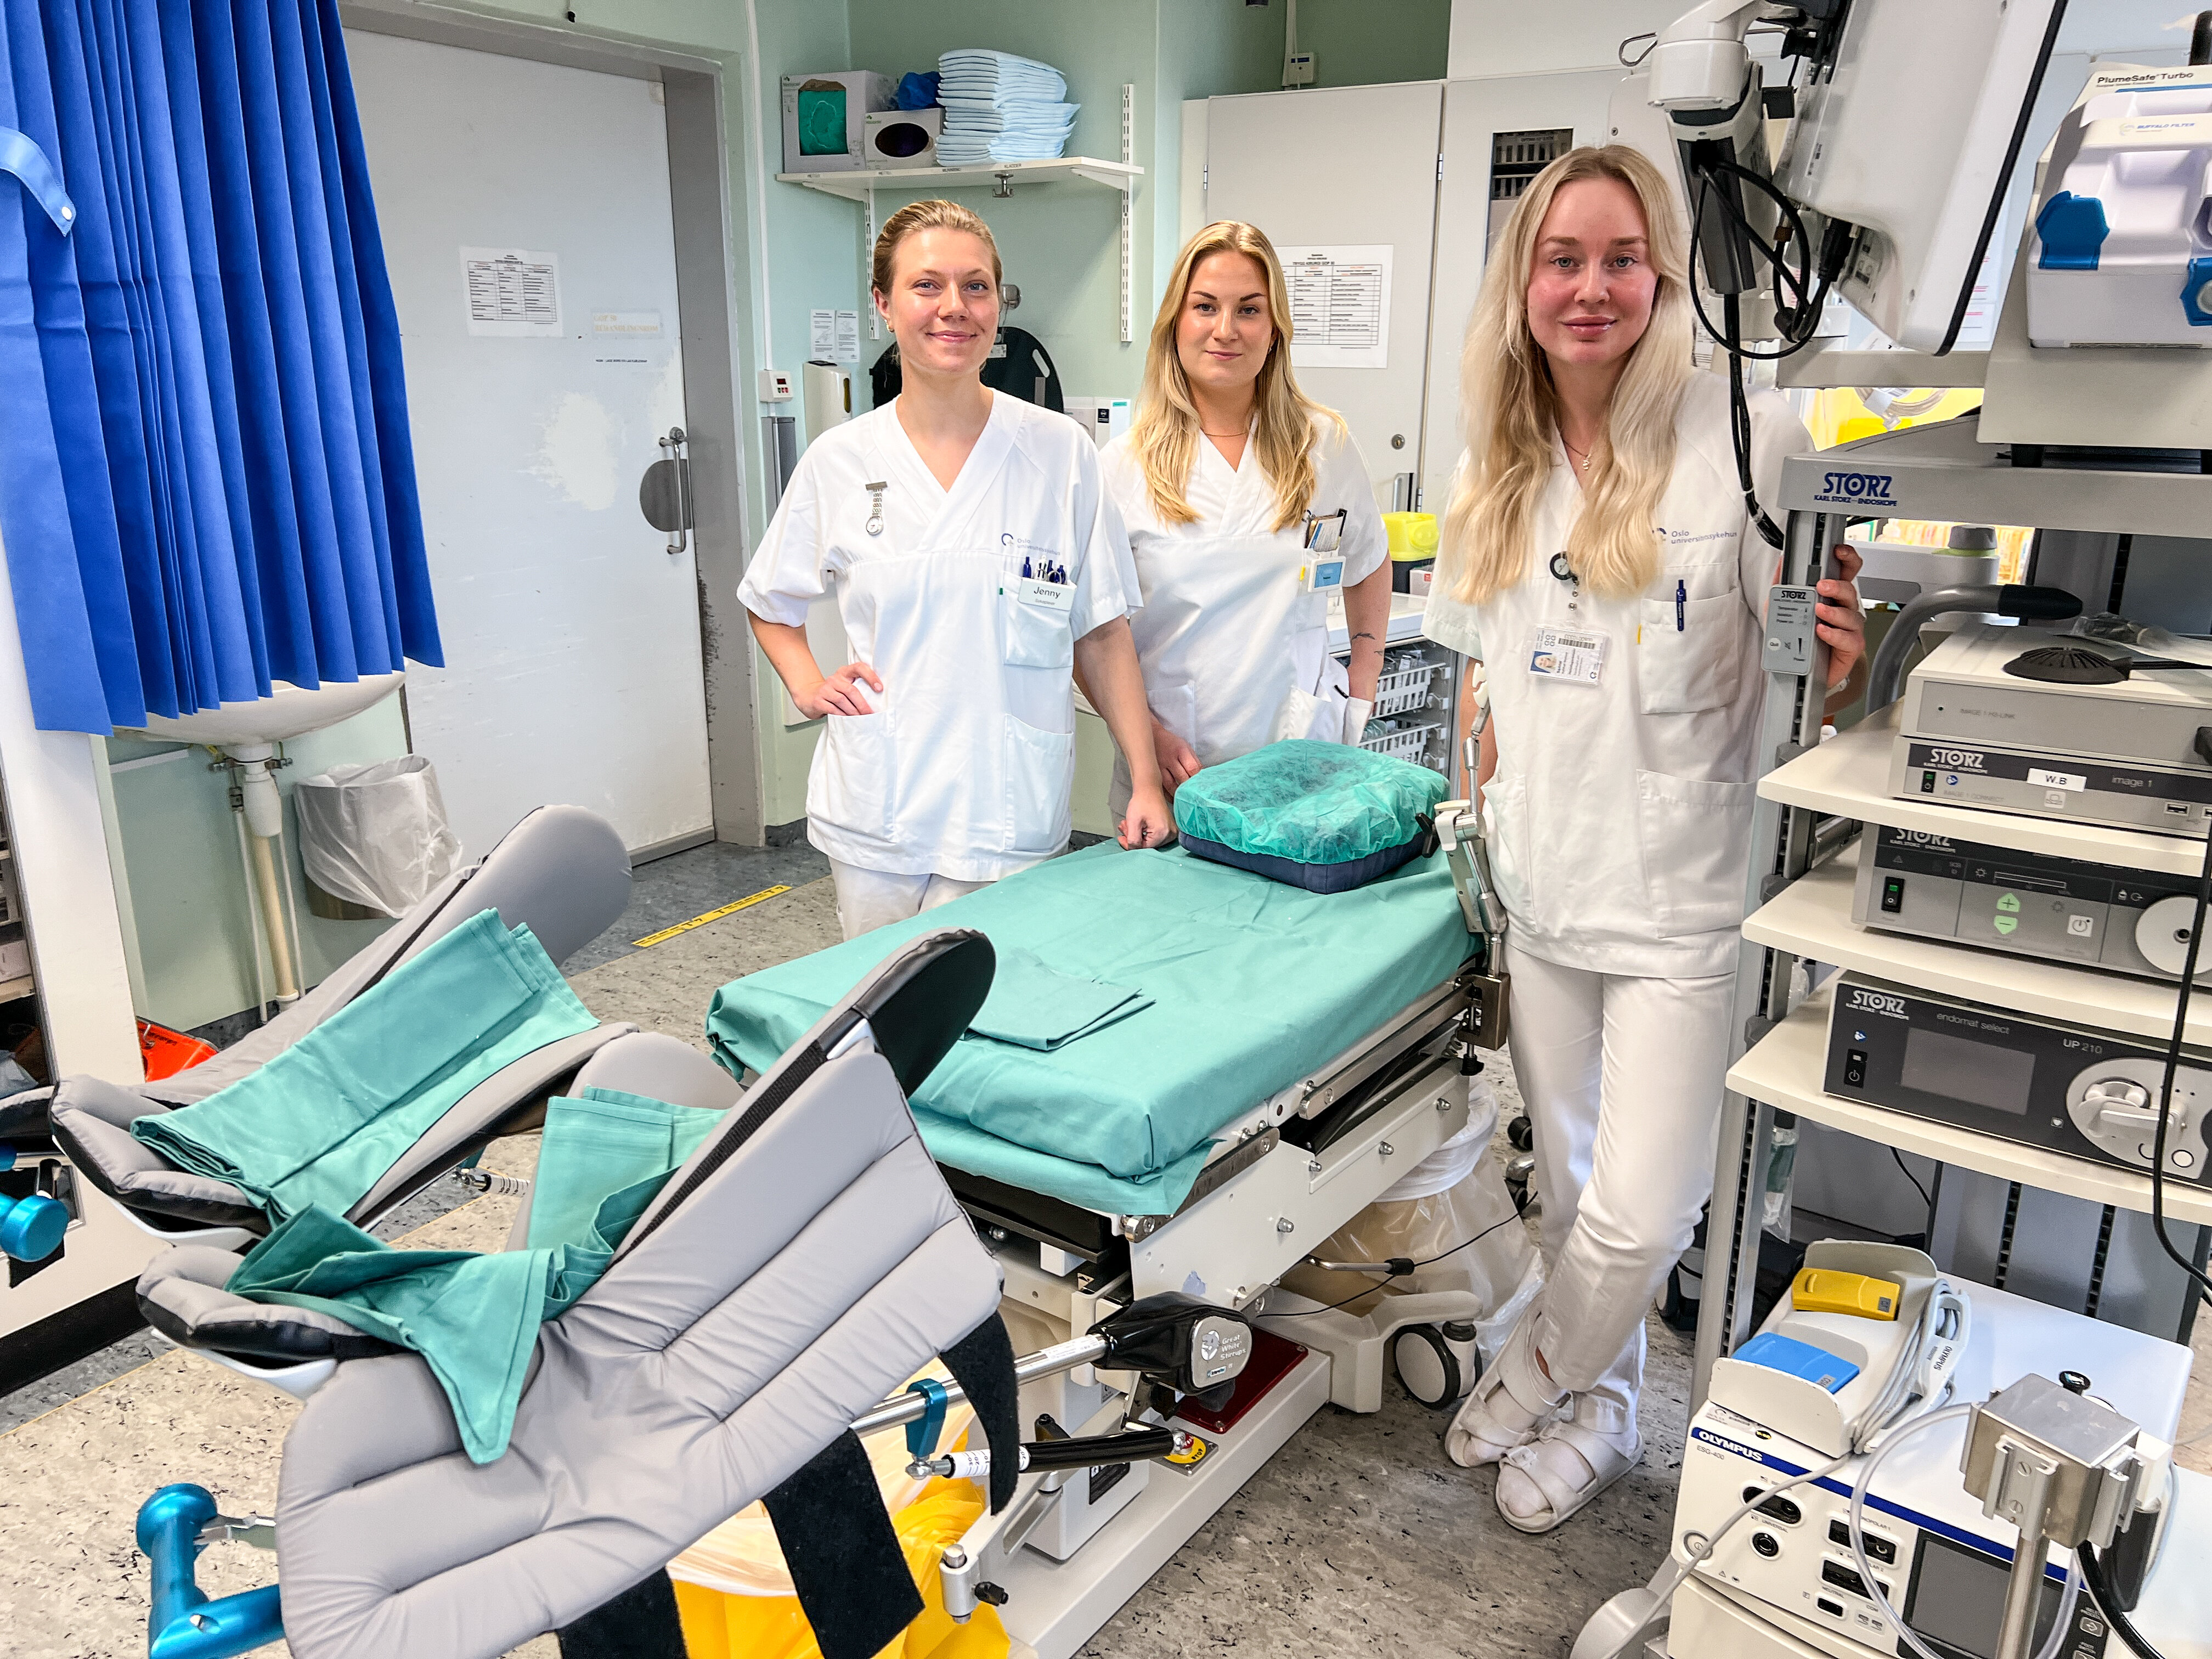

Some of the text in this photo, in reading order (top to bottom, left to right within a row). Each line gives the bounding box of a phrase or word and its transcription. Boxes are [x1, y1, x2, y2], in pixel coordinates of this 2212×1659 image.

[1822, 472, 1893, 498] STORZ
[1858, 498, 1898, 506] ENDOSKOPE
[1034, 586, 1061, 599] Jenny
[1781, 590, 1806, 600] STORZ
[1930, 748, 1984, 768] STORZ
[2112, 775, 2144, 788] image
[1852, 990, 1906, 1014] STORZ
[1937, 1013, 2010, 1035] endomat select
[2063, 1037, 2103, 1054] UP 210
[1222, 1334, 1240, 1345] Great
[1221, 1342, 1240, 1352] White
[1220, 1348, 1246, 1361] Stirrups
[1933, 1346, 1953, 1370] OLYMPUS
[1696, 1445, 1725, 1460] ESG-400
[1699, 1431, 1763, 1461] OLYMPUS
[1866, 1604, 1878, 1612] COM
